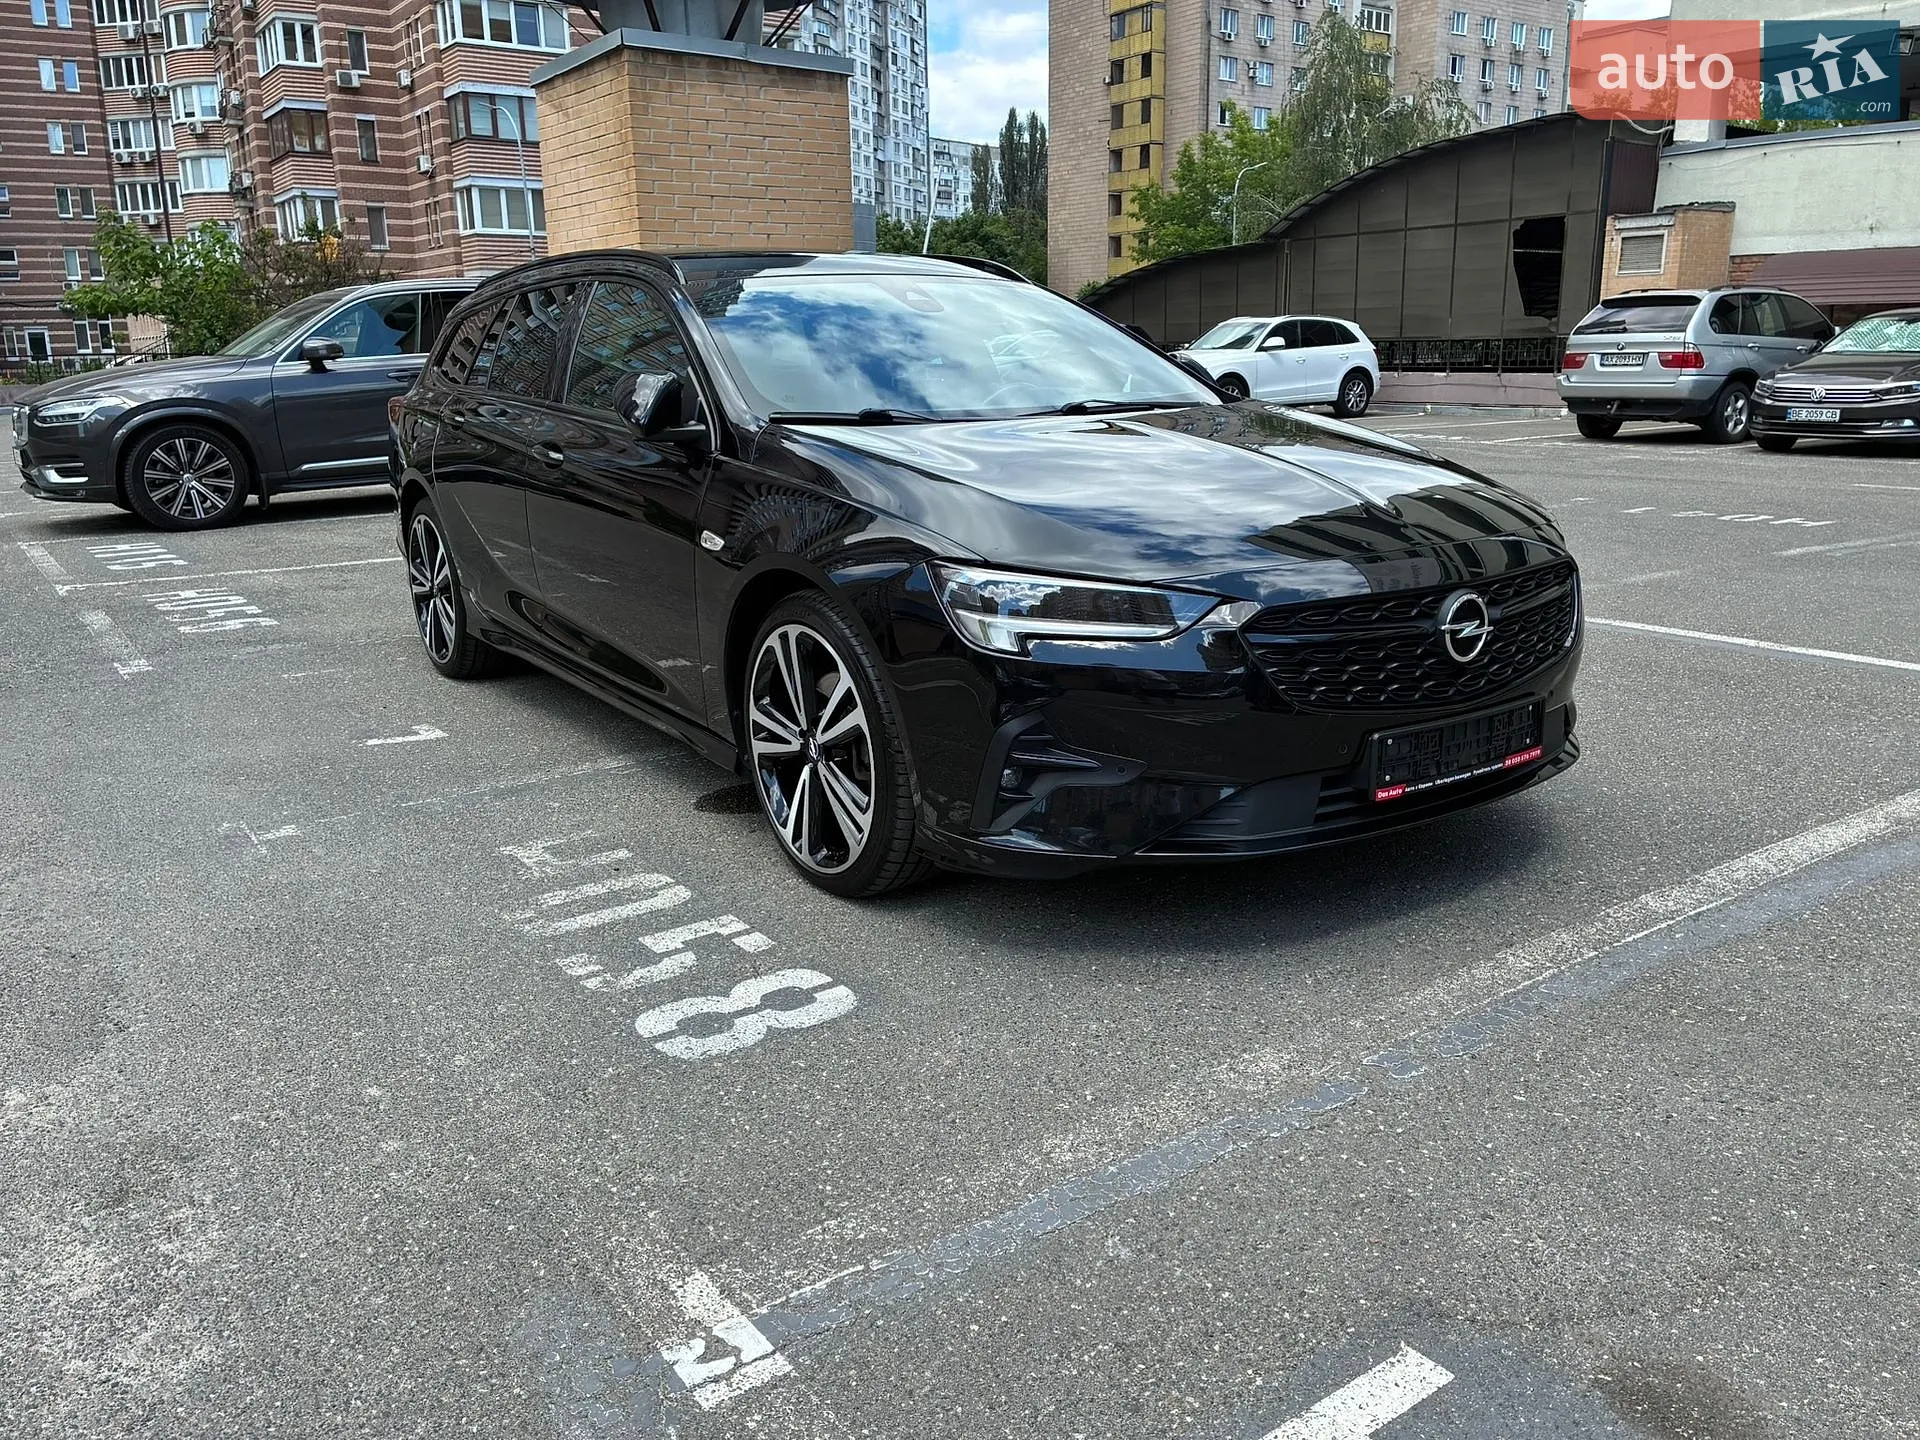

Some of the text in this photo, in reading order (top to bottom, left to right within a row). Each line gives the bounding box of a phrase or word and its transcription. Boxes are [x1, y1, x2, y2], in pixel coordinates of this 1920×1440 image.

[1791, 409, 1838, 419] BE 2059 CB
[1377, 787, 1403, 799] Das Auto
